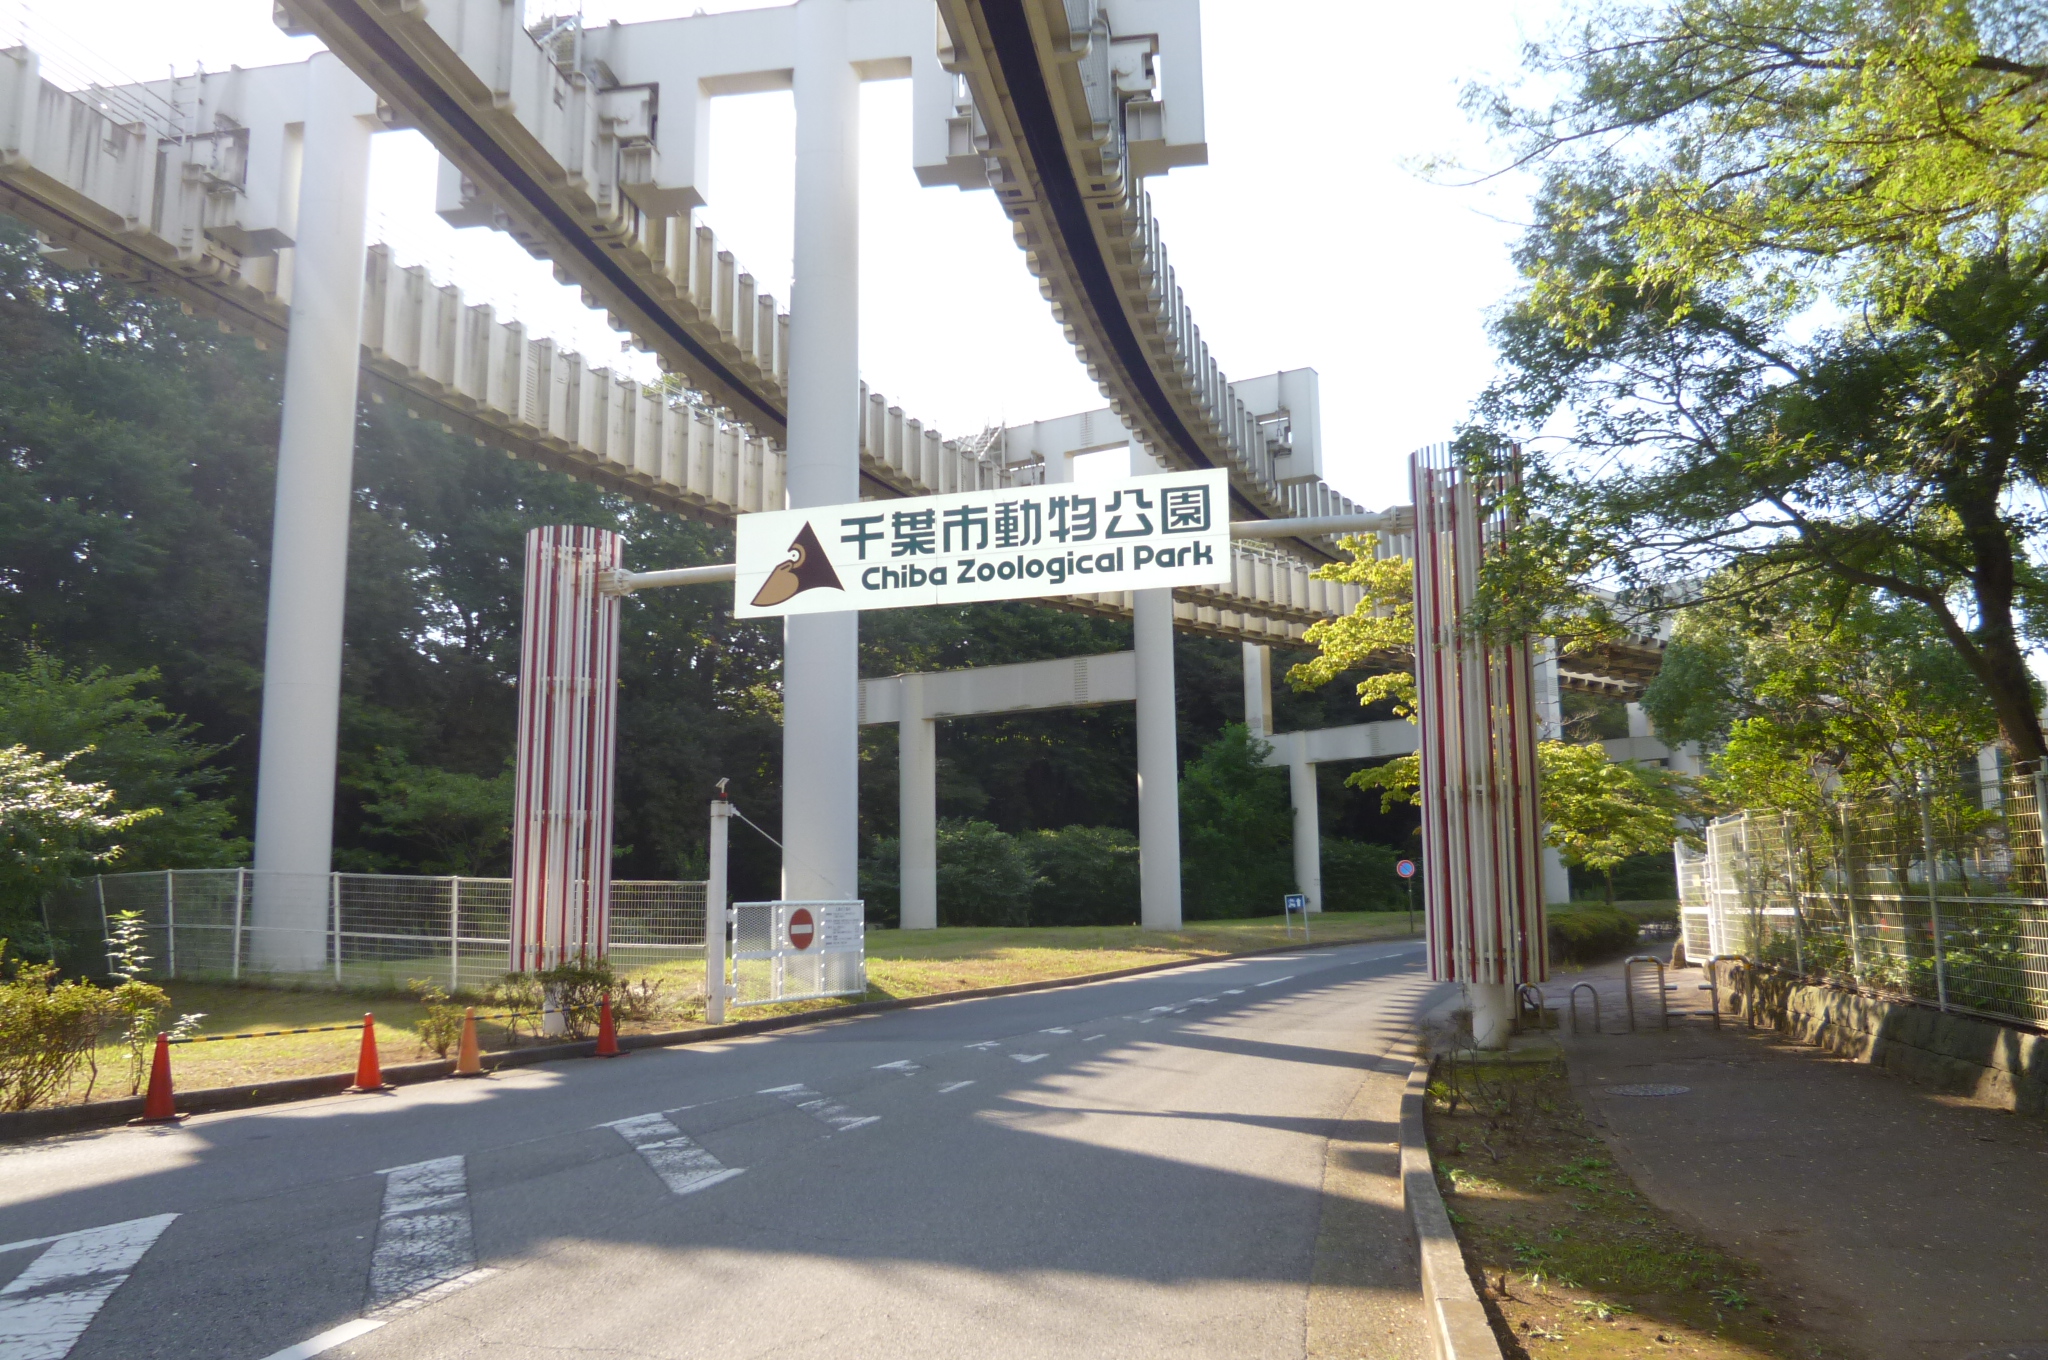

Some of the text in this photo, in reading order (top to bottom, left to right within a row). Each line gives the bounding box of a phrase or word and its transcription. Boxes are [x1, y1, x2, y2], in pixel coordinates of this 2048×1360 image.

[840, 484, 1211, 560] 千葉市動物公園
[861, 540, 1213, 591] Chiba Zoological Park
